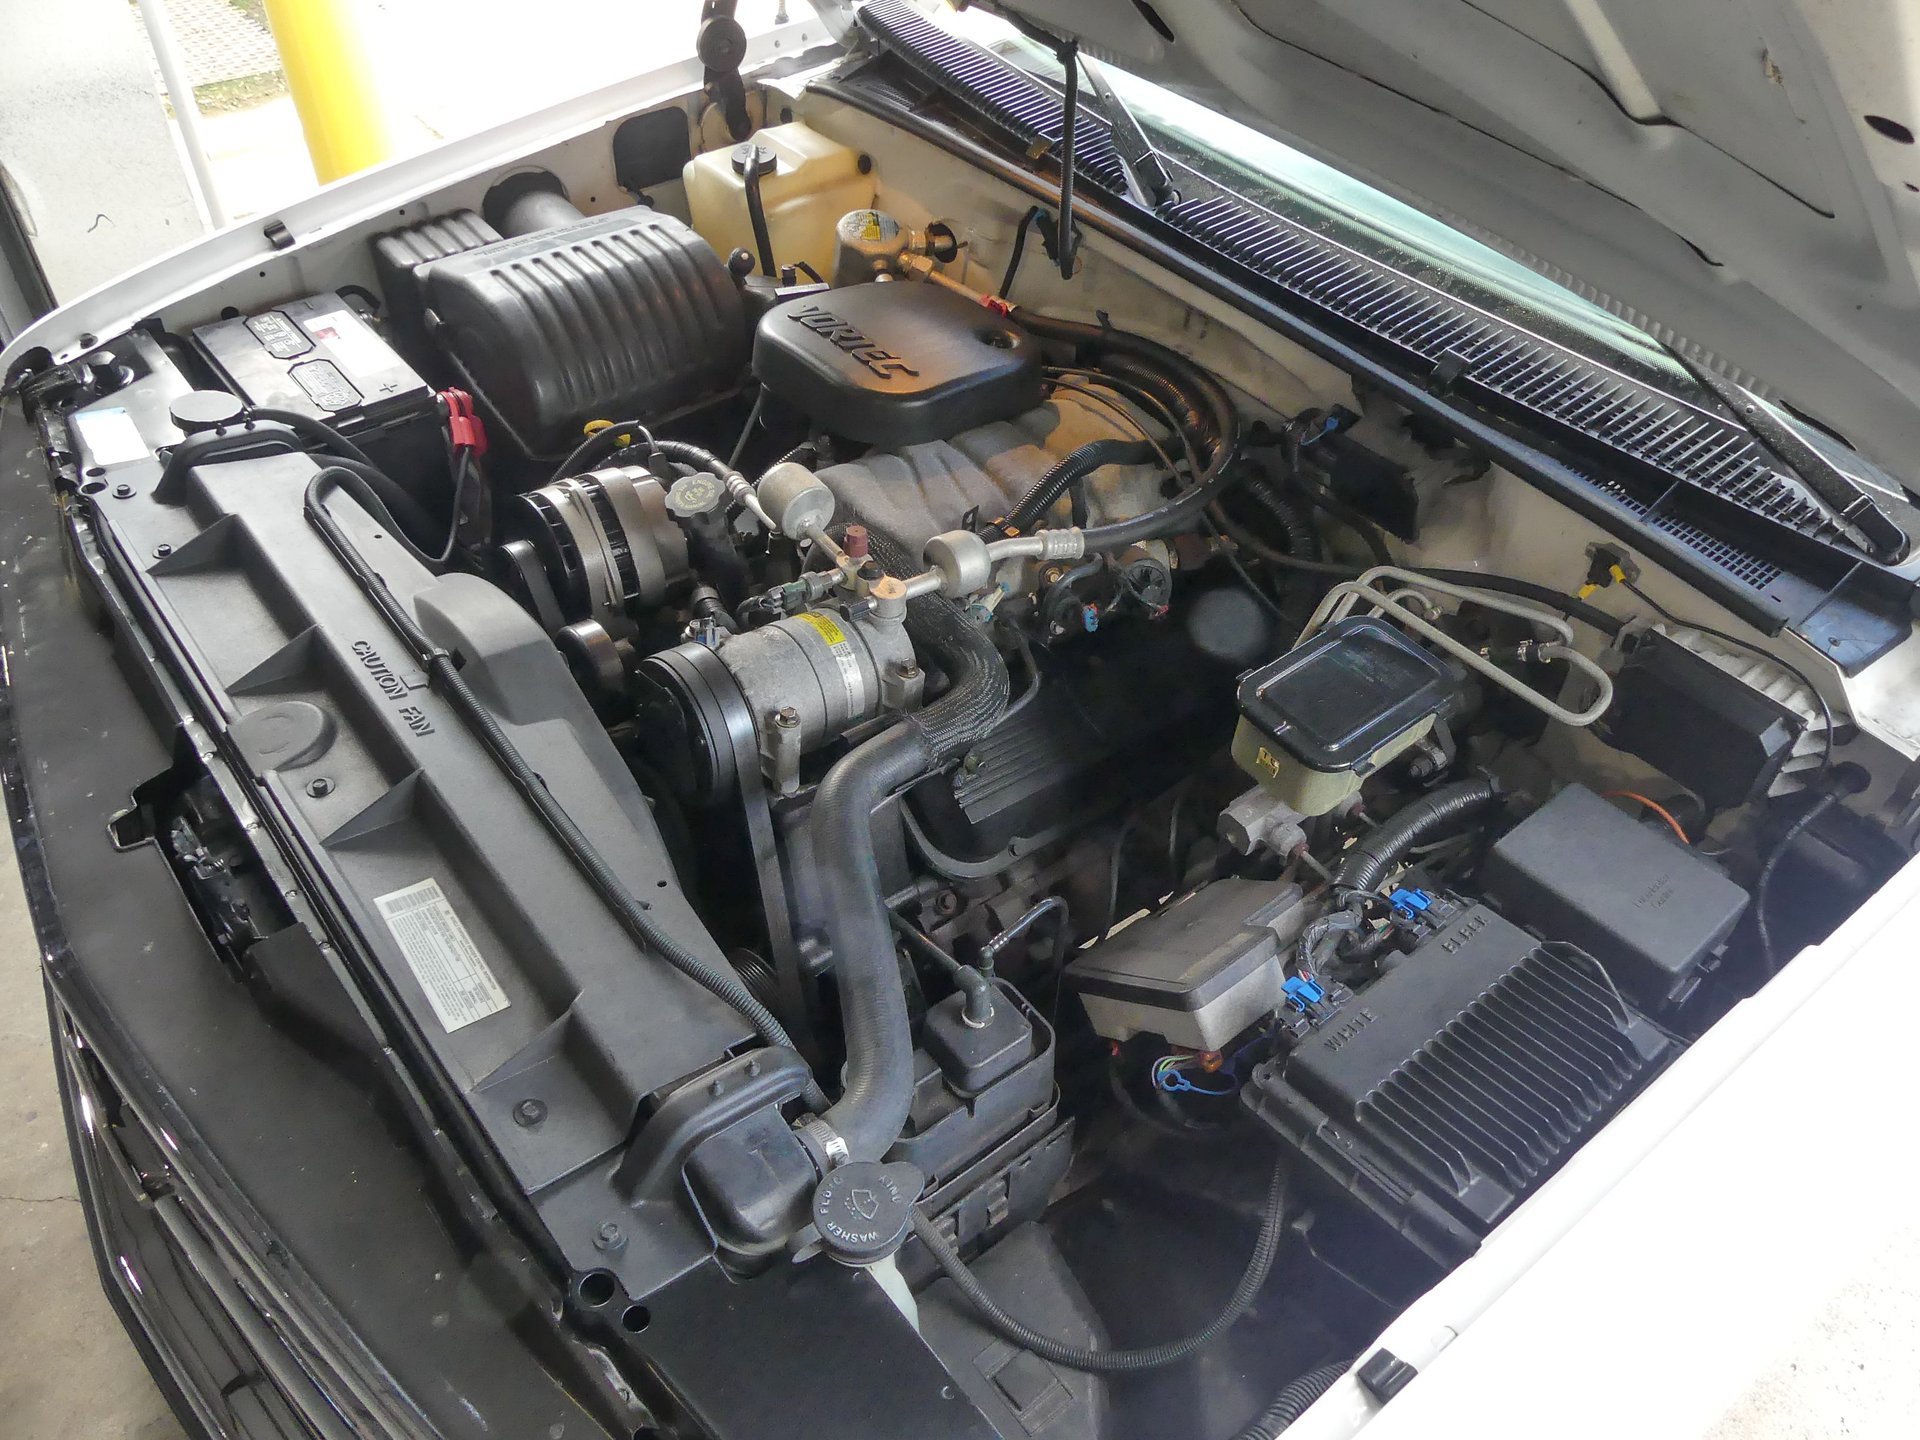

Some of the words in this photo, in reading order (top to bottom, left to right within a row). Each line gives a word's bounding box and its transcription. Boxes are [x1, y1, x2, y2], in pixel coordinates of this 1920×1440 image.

[787, 305, 921, 380] VORTEC
[351, 640, 408, 701] CAUTION
[398, 706, 436, 738] FAN
[1324, 1007, 1379, 1052] WHITE
[819, 1175, 843, 1215] FLUID
[826, 1220, 881, 1244] WASHER
